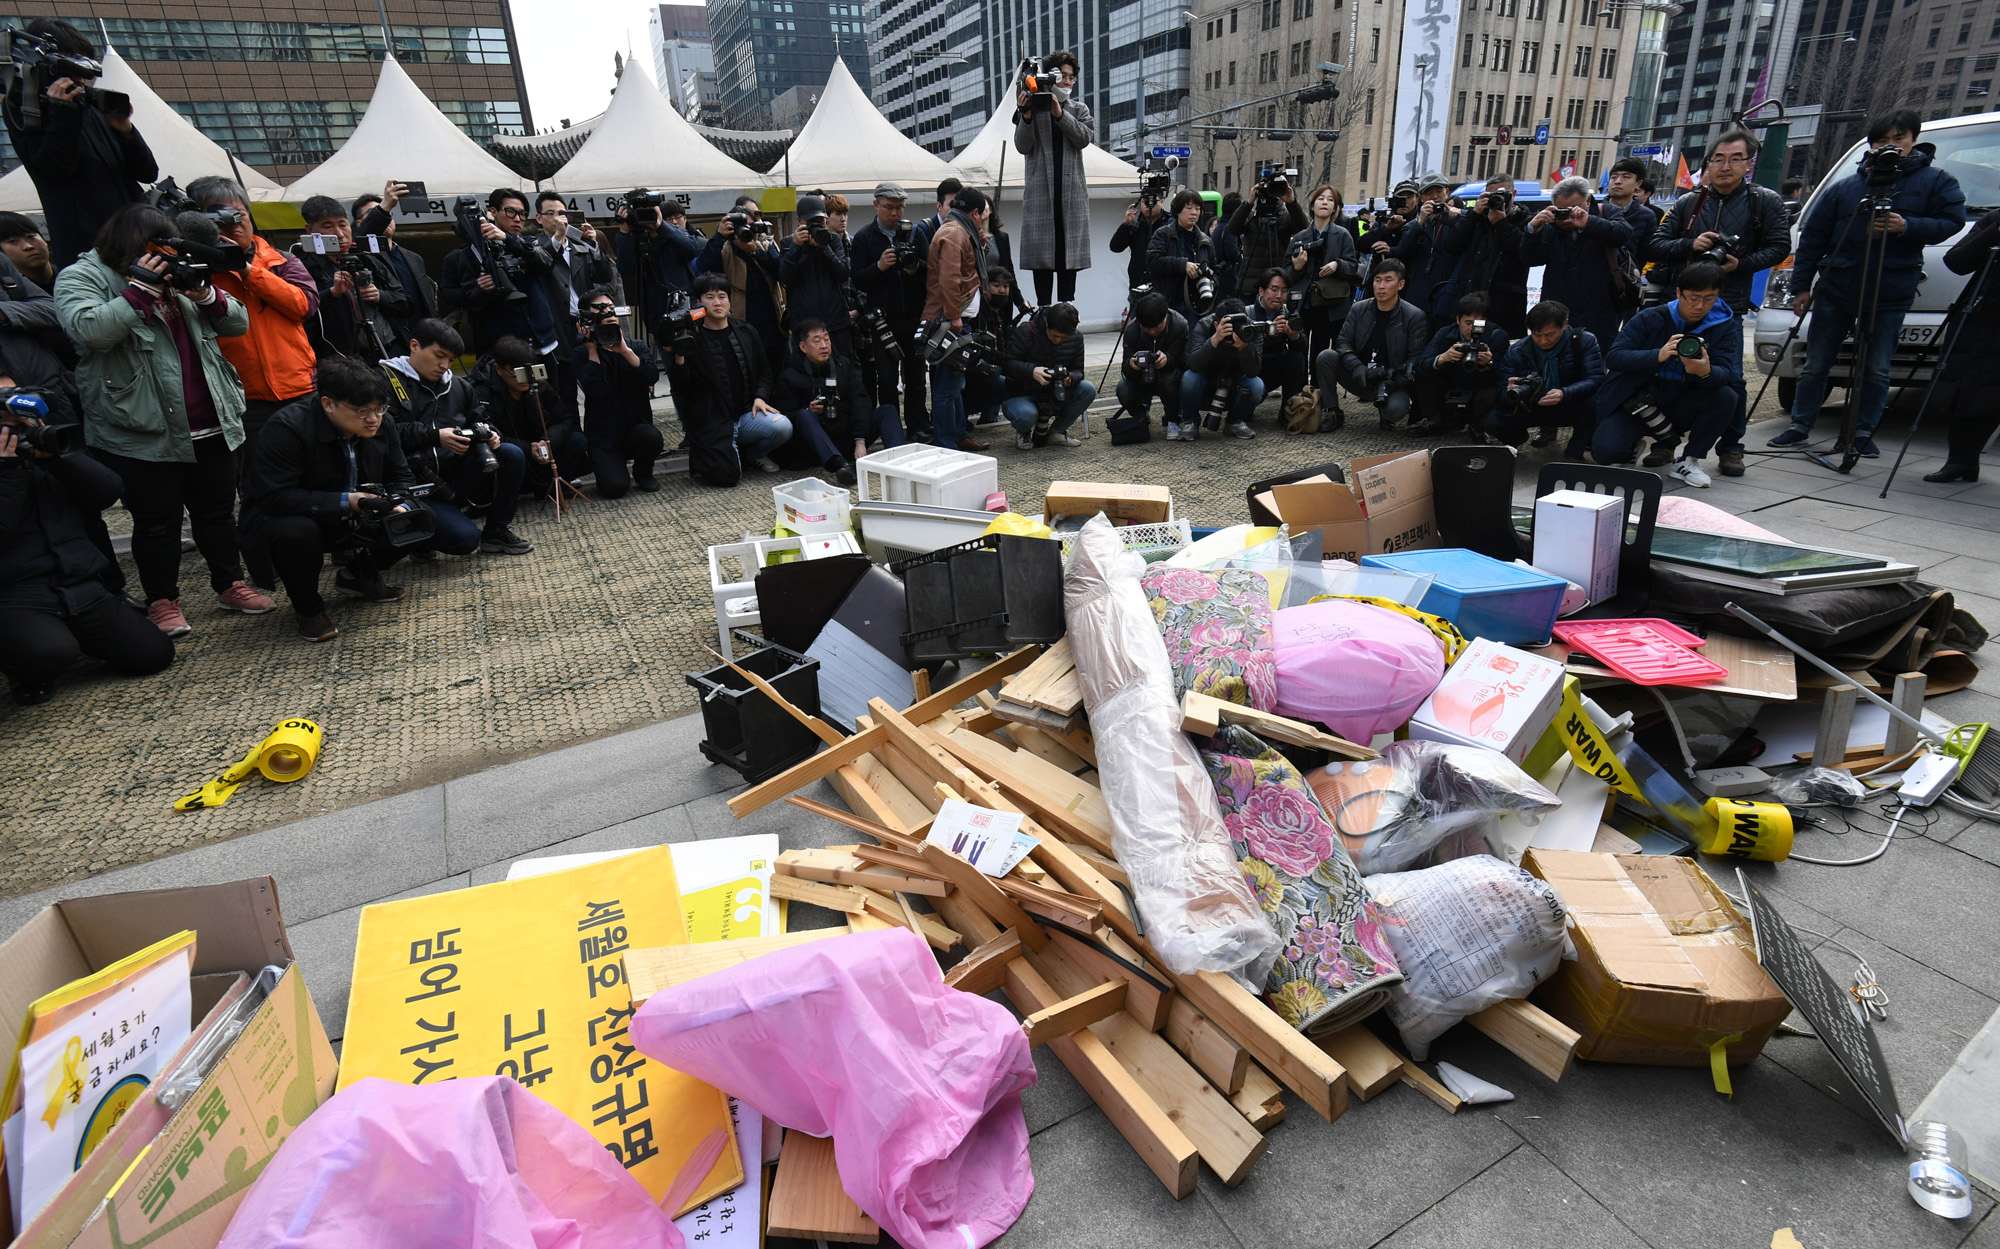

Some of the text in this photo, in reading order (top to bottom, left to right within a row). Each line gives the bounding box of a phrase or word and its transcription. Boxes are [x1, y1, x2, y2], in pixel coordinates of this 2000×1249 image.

[1365, 477, 1387, 490] coupang
[1394, 522, 1430, 551] 로켓프레시
[1566, 711, 1602, 766] WAR
[404, 927, 463, 1004] 넘어
[495, 1008, 553, 1088] 그냥
[577, 899, 660, 1170] 세월호 진상규명
[137, 1124, 194, 1201] FOAMBOARD
